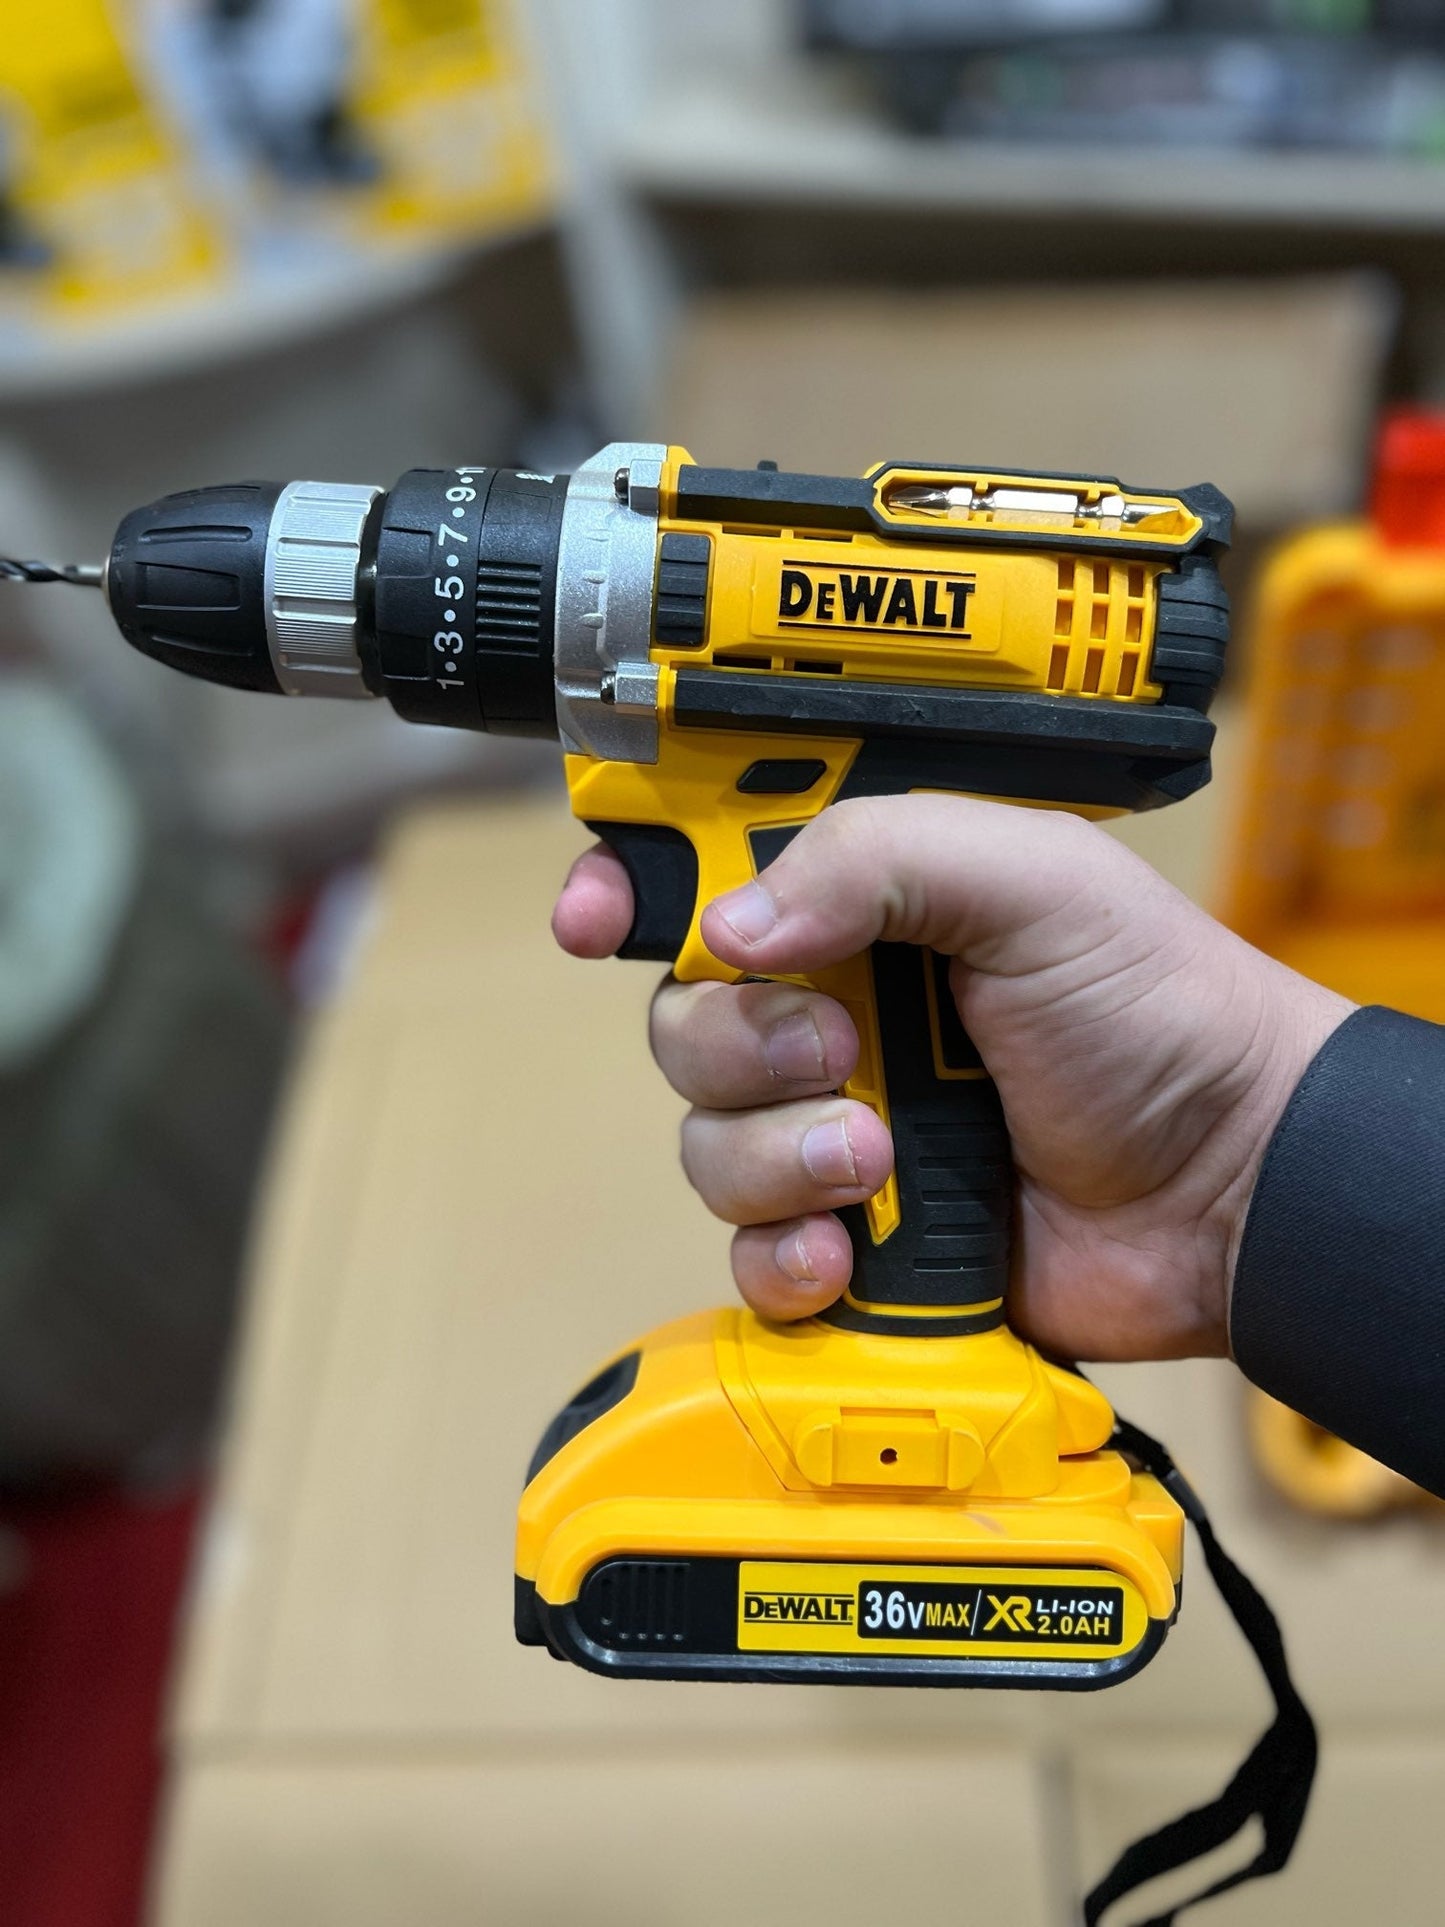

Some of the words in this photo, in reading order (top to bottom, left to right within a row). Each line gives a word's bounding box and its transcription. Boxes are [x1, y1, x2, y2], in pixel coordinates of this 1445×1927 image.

[983, 1595, 1035, 1631] XR
[1036, 1599, 1113, 1615] LI-ION
[1037, 1615, 1110, 1636] 2.0AH
